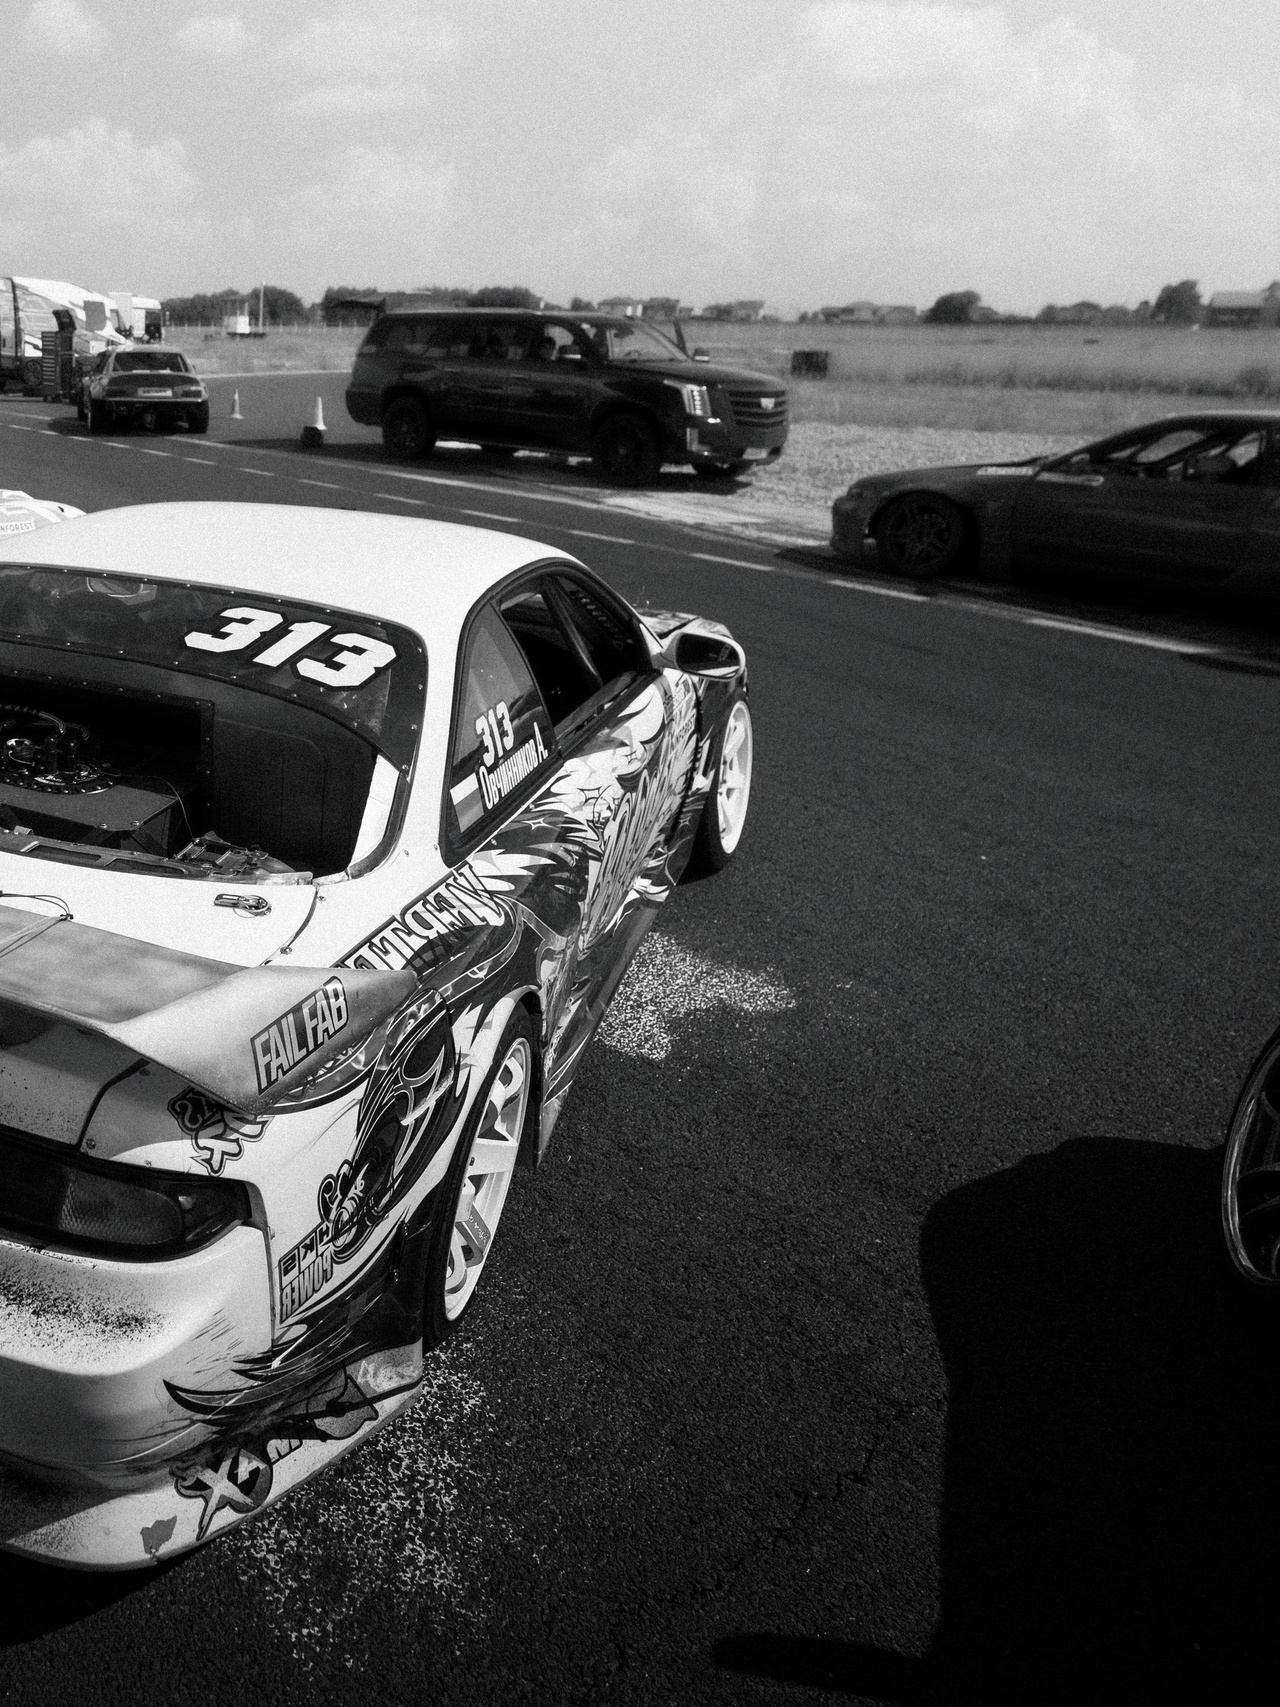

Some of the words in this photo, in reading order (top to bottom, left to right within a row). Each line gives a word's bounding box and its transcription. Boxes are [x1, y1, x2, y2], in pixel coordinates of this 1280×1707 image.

[184, 606, 397, 687] 313
[475, 701, 514, 768] 313
[253, 1024, 307, 1090] FAIL
[301, 978, 349, 1052] FAB
